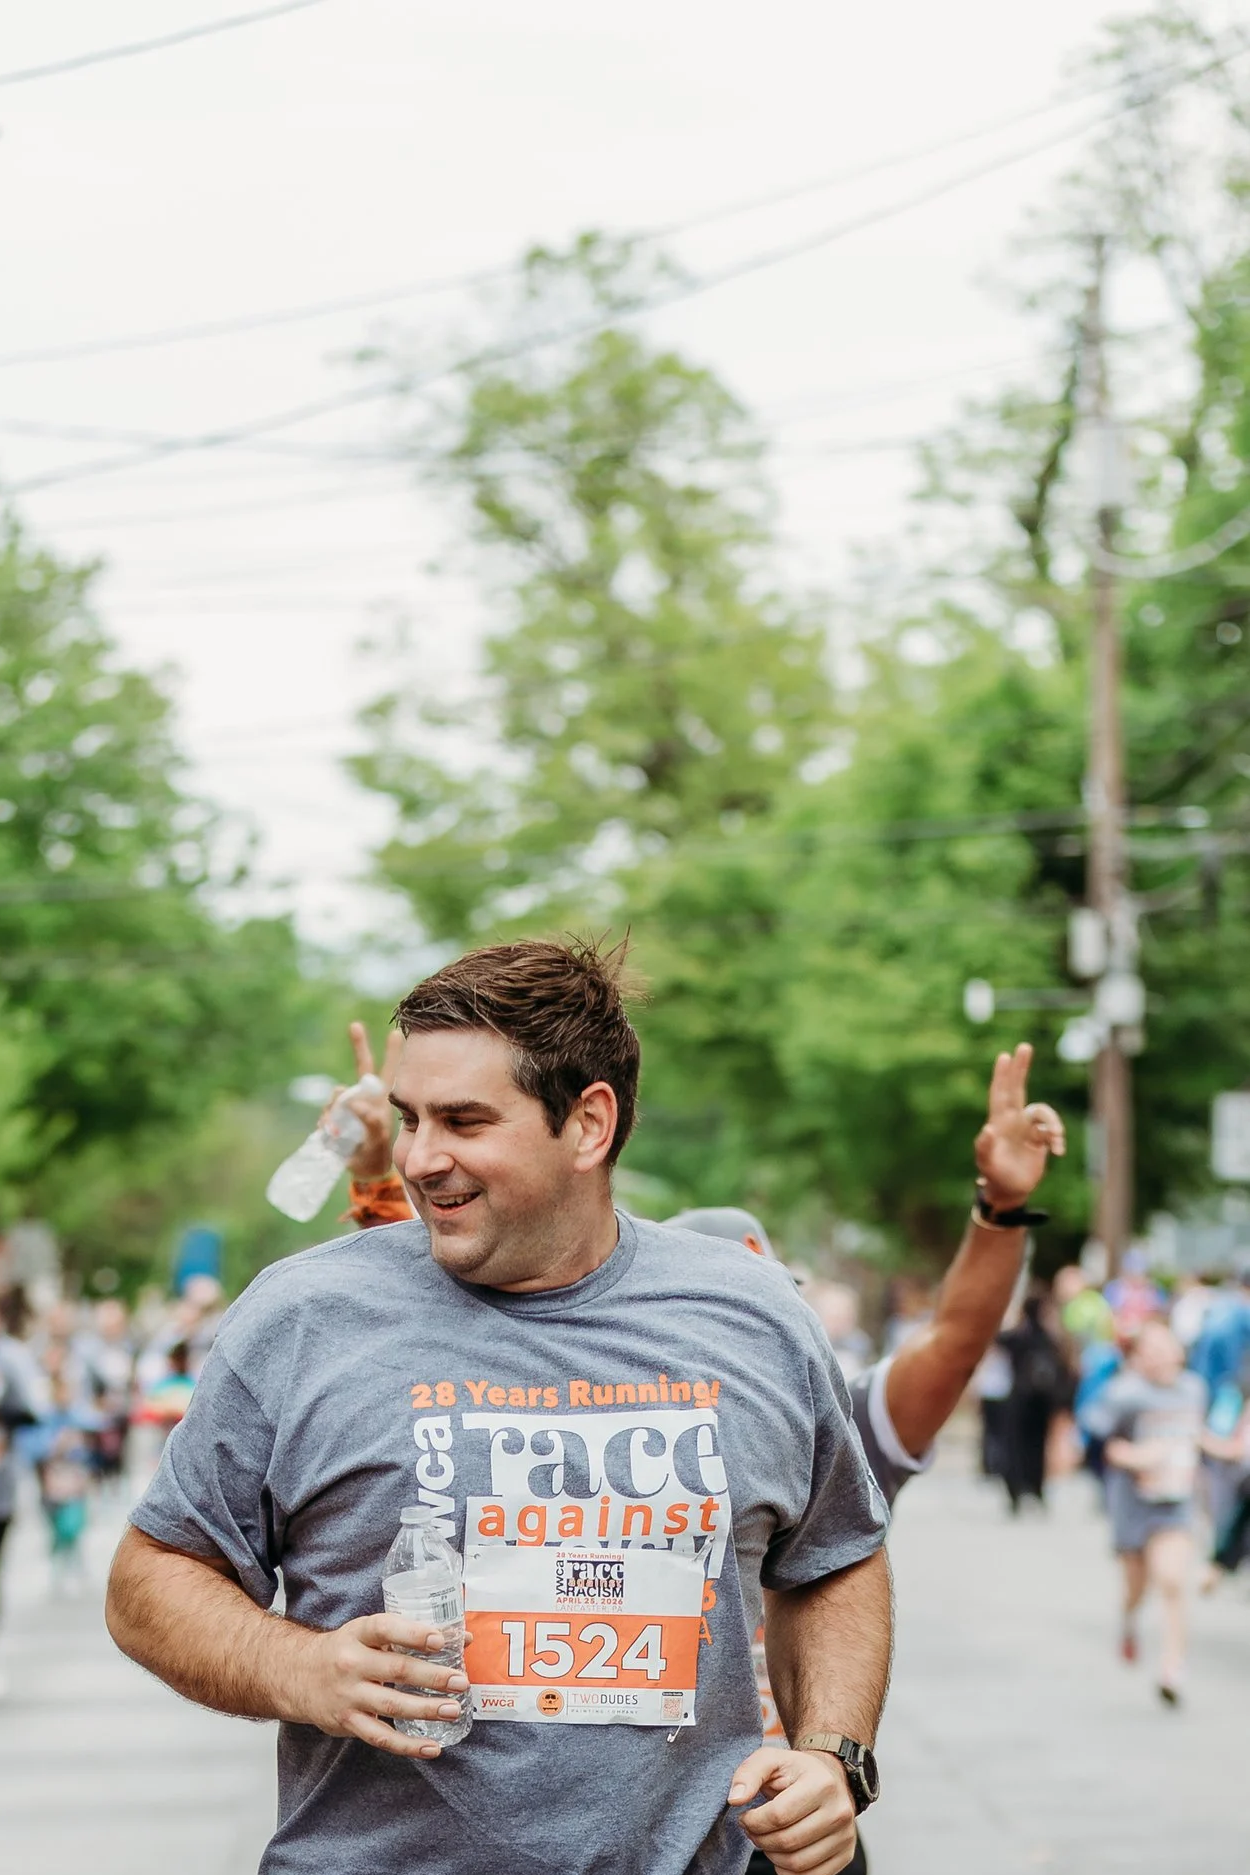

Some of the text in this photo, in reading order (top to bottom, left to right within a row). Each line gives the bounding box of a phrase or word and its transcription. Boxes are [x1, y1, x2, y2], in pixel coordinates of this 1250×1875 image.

[410, 1373, 722, 1409] 28 Years Running!
[463, 1422, 729, 1500] race
[413, 1415, 457, 1555] wca
[477, 1495, 720, 1547] against
[567, 1562, 624, 1580] race
[590, 1553, 625, 1561] Running!
[556, 1560, 566, 1595] ywca
[567, 1585, 624, 1598] RACISM
[501, 1620, 668, 1681] 1524
[481, 1698, 515, 1708] ywca
